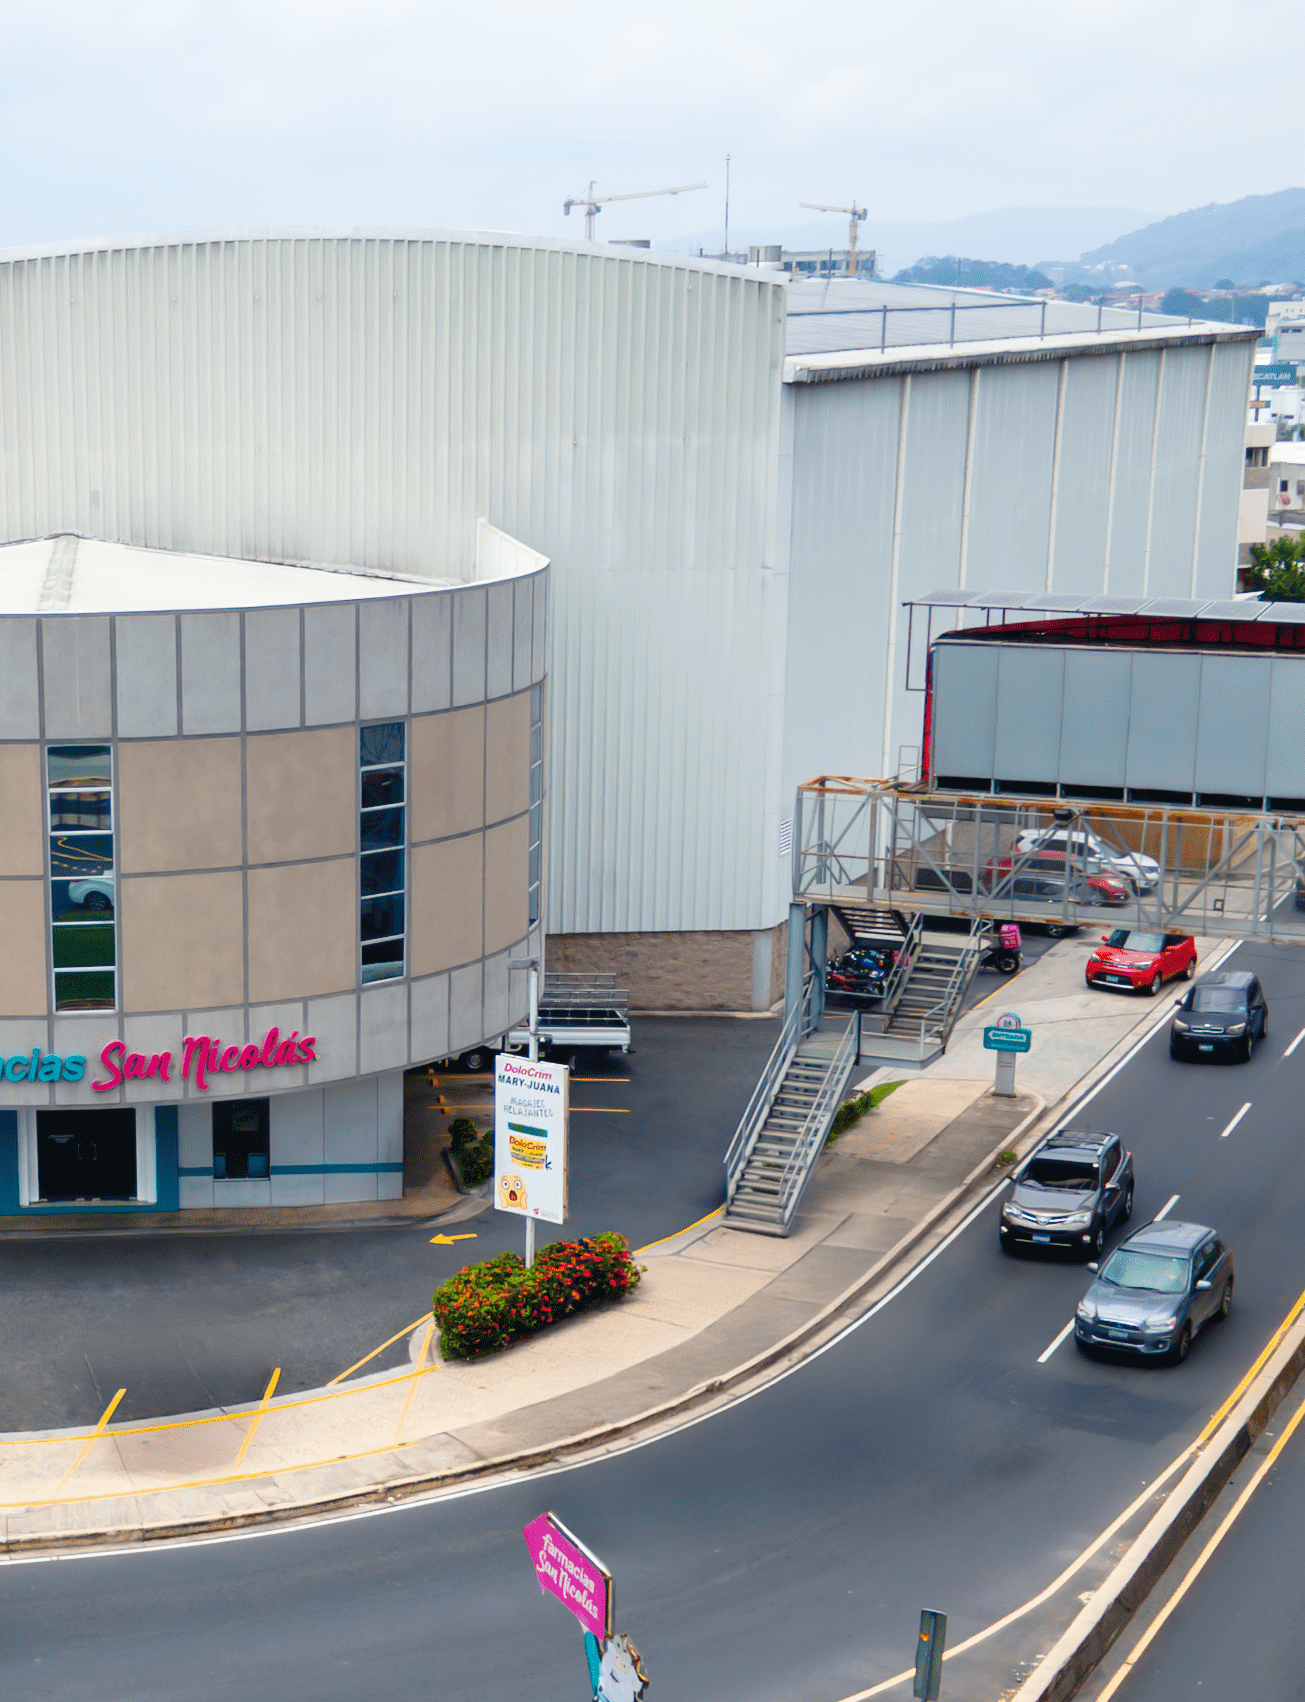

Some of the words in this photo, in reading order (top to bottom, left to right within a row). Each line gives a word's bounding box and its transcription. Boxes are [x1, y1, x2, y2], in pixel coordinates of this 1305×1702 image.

[91, 1039, 172, 1092] San
[181, 1026, 317, 1091] Nicolás
[497, 1073, 560, 1095] MARY-JUANA
[536, 1549, 558, 1585] San
